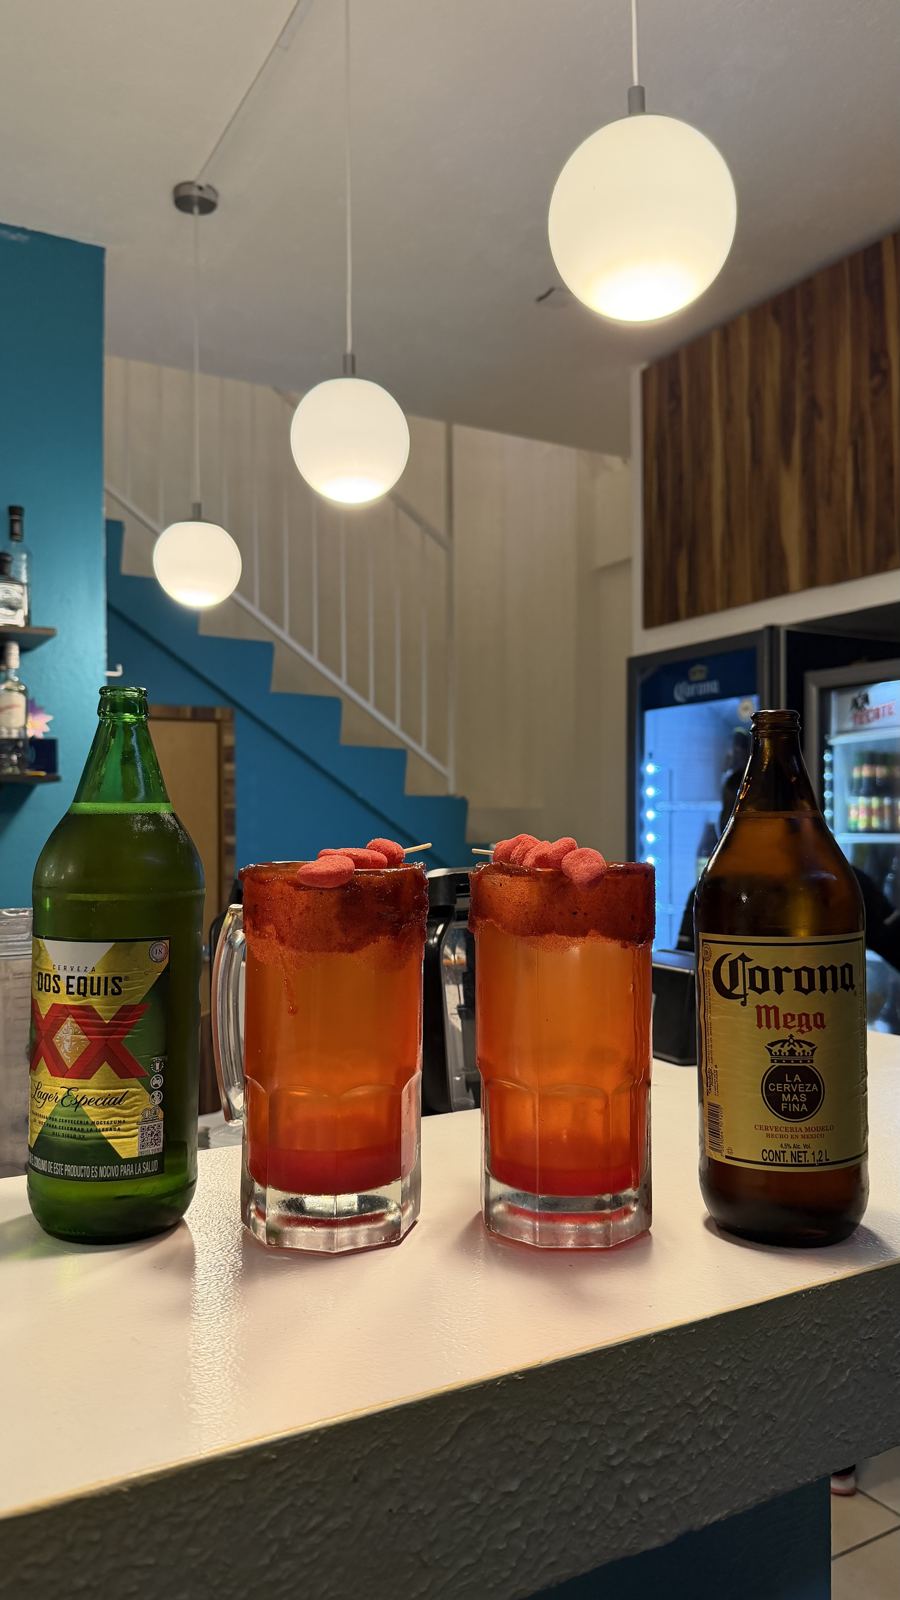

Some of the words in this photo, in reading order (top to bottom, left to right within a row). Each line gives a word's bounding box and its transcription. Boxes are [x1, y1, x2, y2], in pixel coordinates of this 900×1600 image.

[52, 964, 96, 972] CERVEZA
[37, 971, 61, 994] DOS
[65, 975, 123, 997] EQUIS
[712, 952, 856, 1007] Corona
[755, 1004, 826, 1034] Mega
[785, 1073, 802, 1083] LA
[768, 1082, 819, 1092] CERVEZA
[31, 1081, 60, 1109] Lager
[60, 1086, 129, 1111] Especial
[781, 1093, 807, 1102] MAS
[781, 1102, 808, 1112] FINA
[761, 1148, 789, 1162] CONT.
[790, 1150, 810, 1162] NET.
[53, 1162, 64, 1176] ESTE
[64, 1164, 91, 1178] PRODUCTO
[91, 1165, 99, 1178] ES
[99, 1165, 120, 1178] NOCIVO
[120, 1163, 135, 1177] PARA
[135, 1162, 142, 1175] LA
